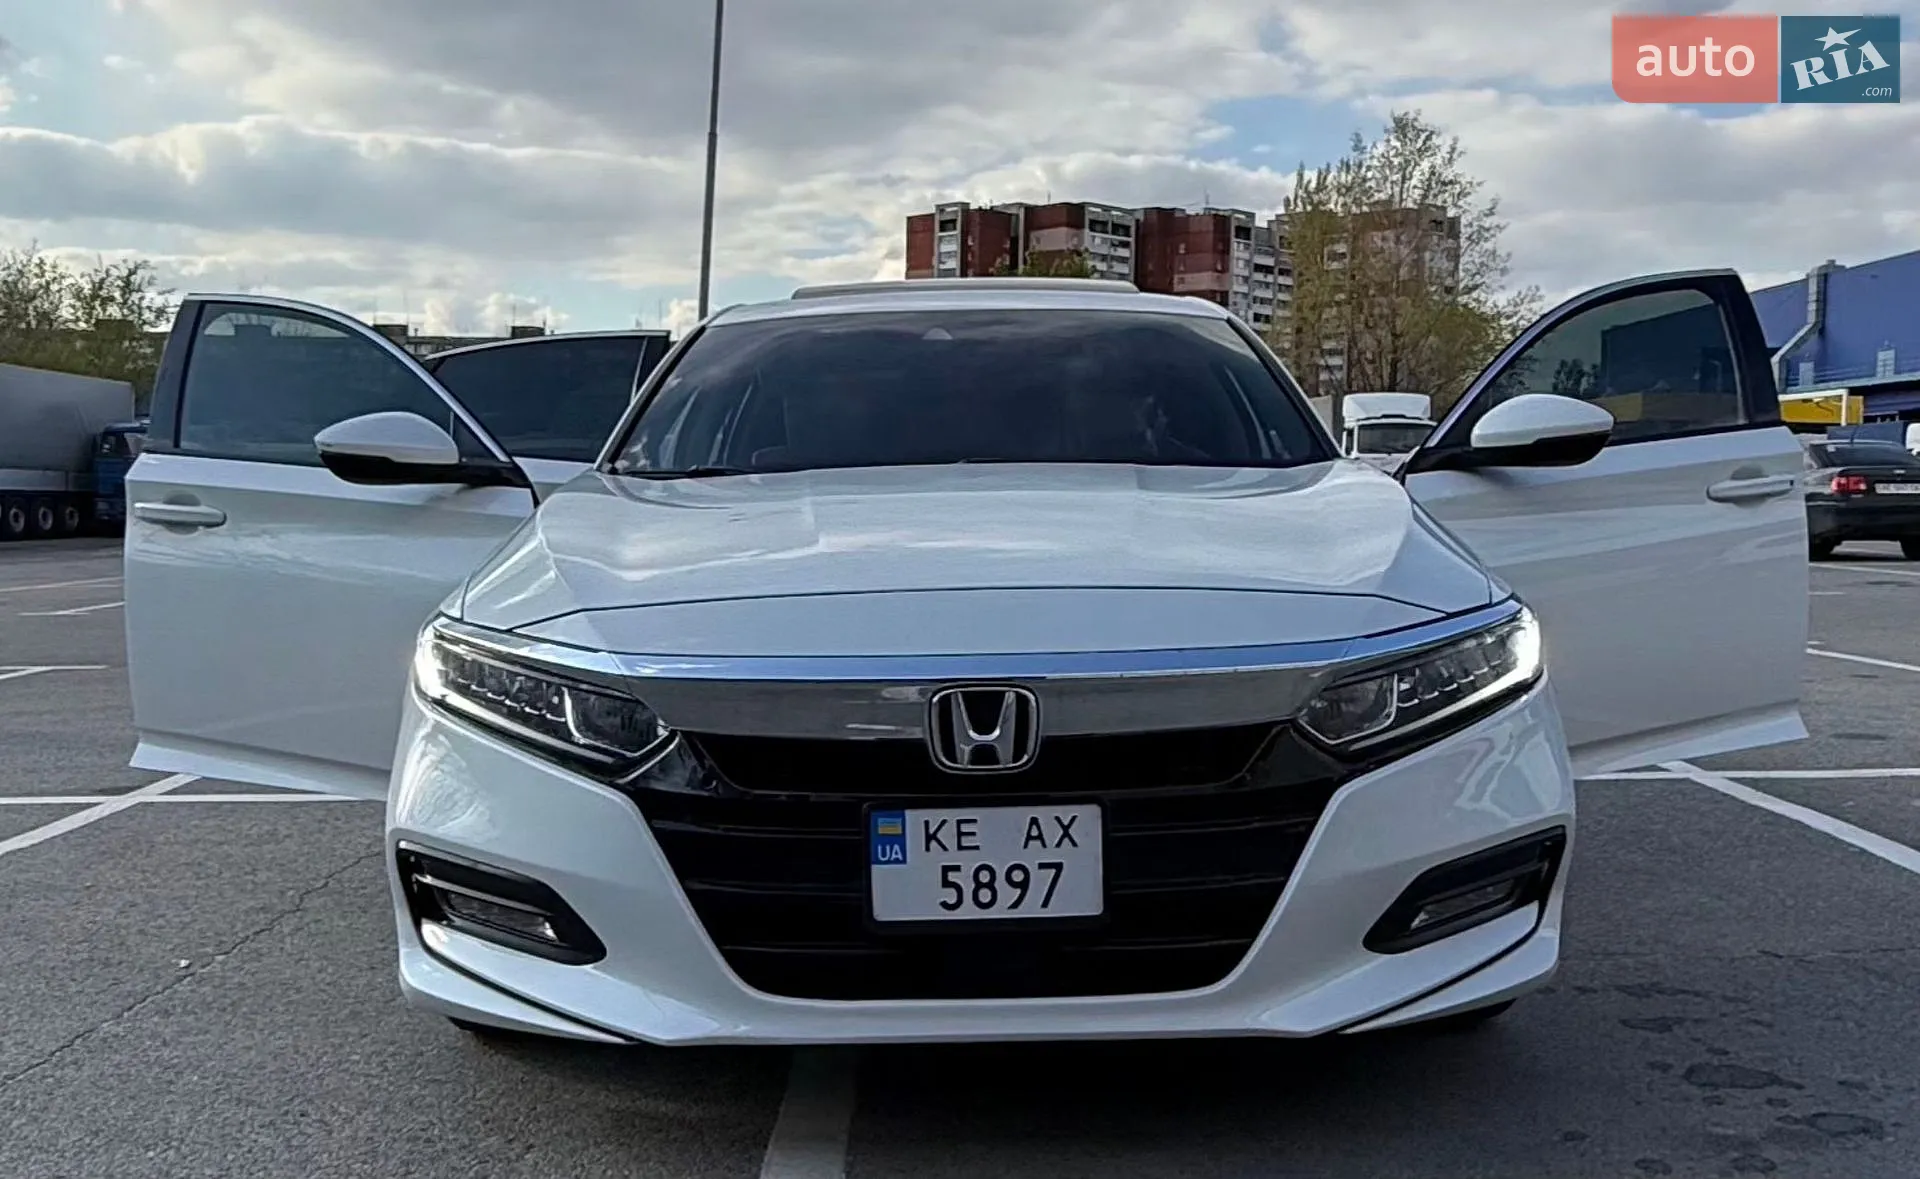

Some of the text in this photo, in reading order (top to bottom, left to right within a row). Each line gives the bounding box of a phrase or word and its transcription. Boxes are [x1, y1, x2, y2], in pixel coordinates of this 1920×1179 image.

[923, 815, 1079, 852] KE AX
[877, 844, 904, 861] UA
[938, 861, 1064, 911] 5897
